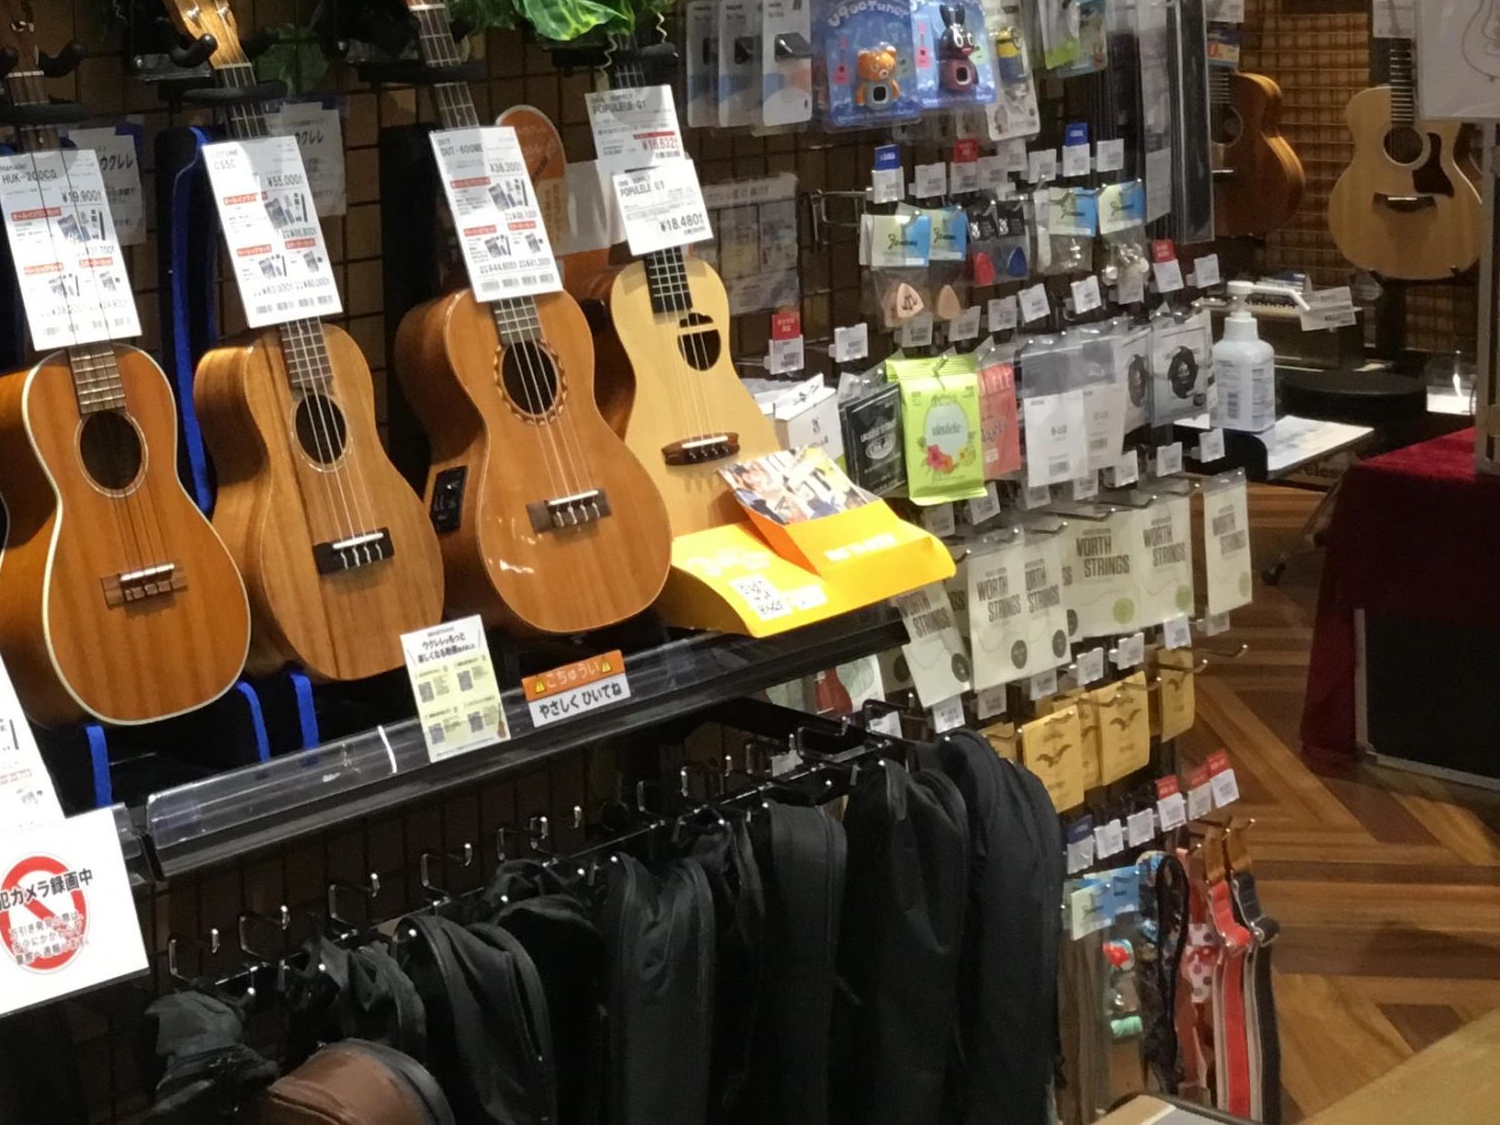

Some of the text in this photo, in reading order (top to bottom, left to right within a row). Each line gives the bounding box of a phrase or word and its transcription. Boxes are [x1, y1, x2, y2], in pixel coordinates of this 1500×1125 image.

[1084, 554, 1130, 578] STRINGS
[977, 576, 1009, 602] WORTH
[539, 682, 623, 720] やさしく ひいてね
